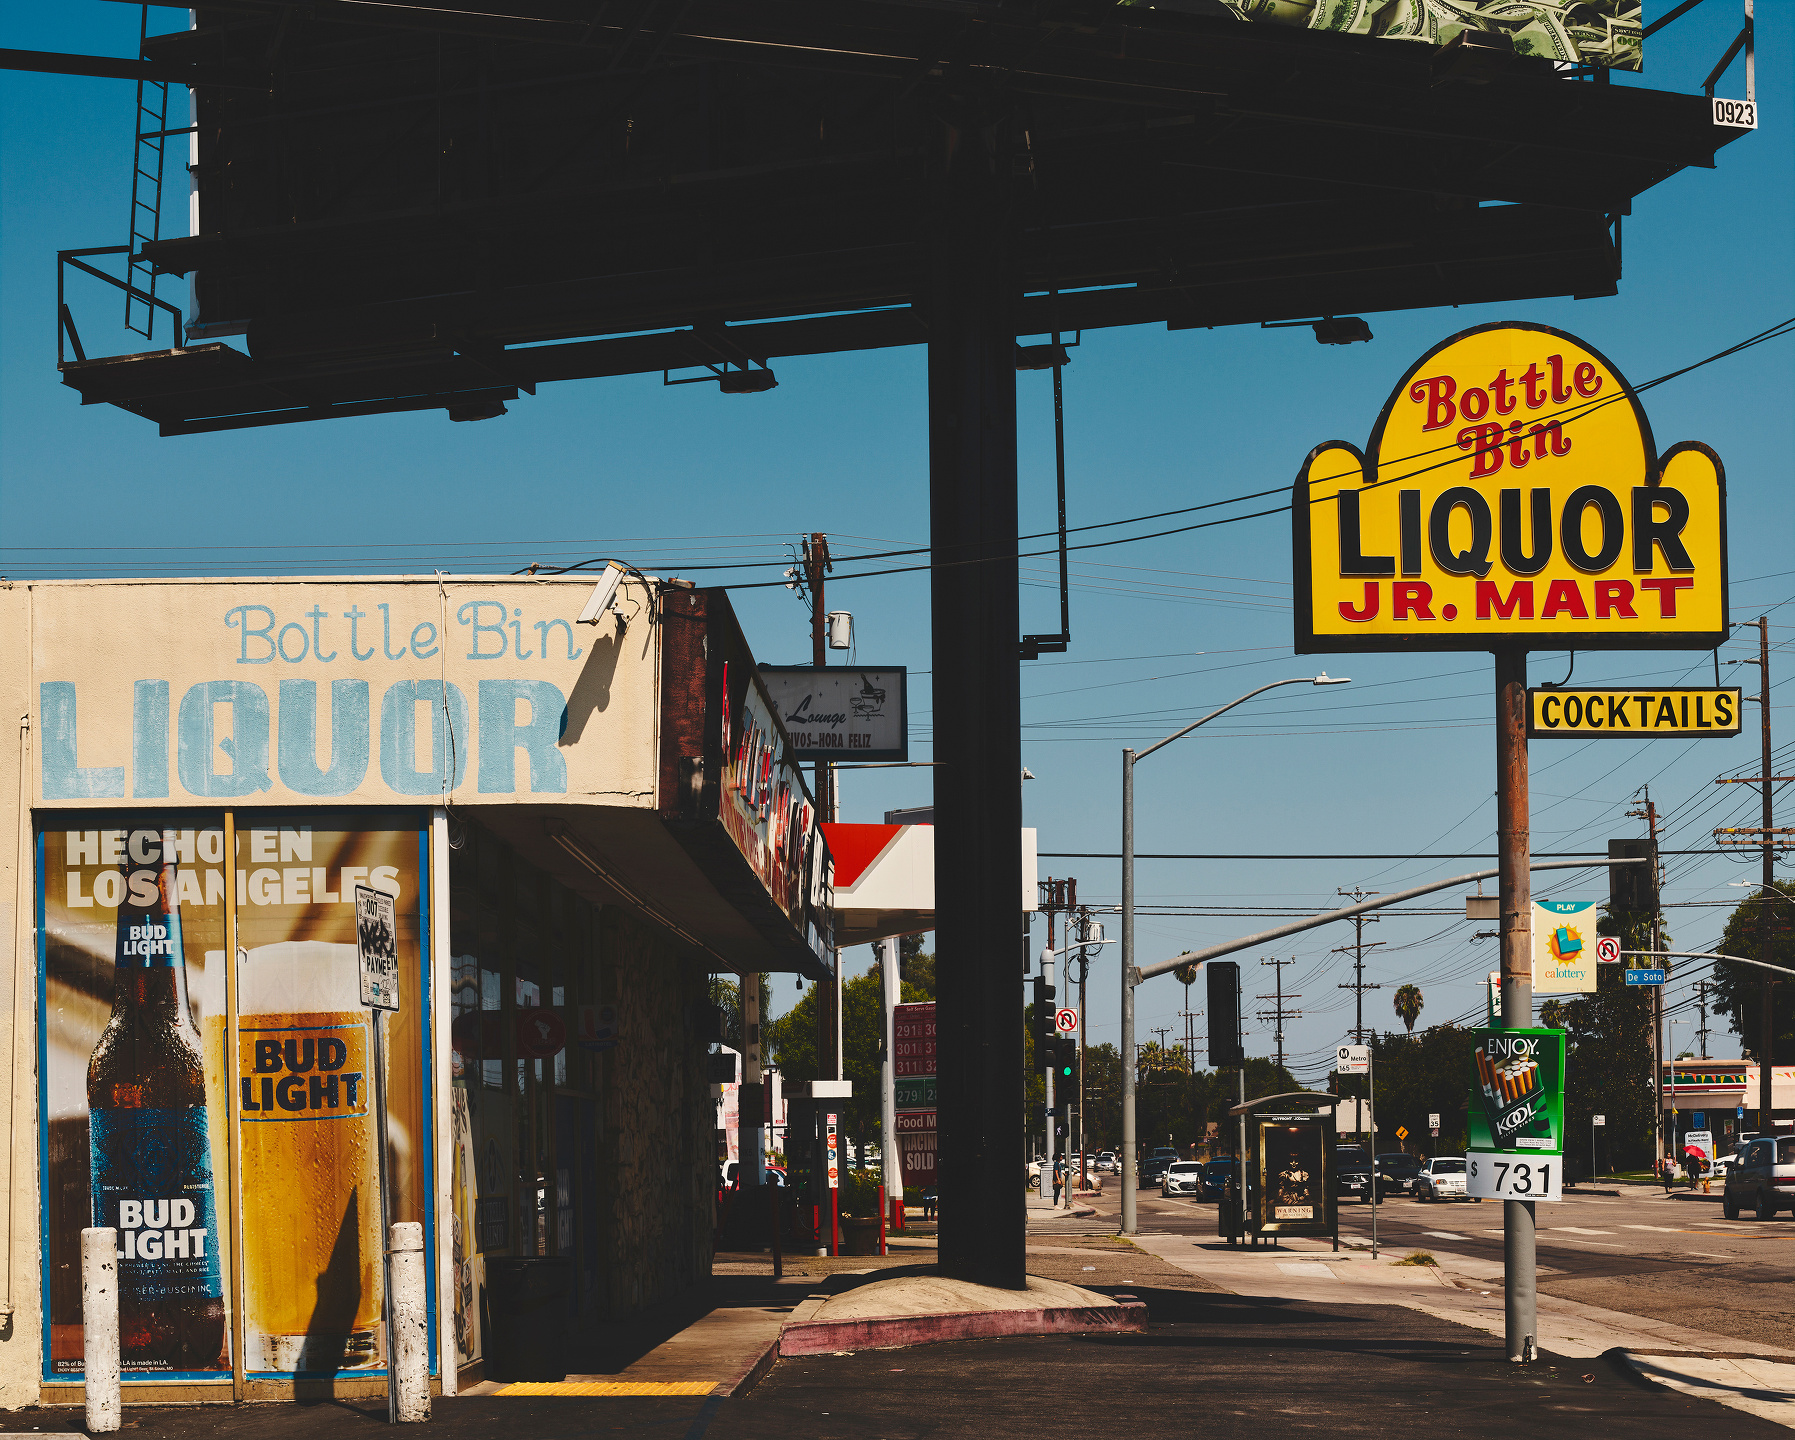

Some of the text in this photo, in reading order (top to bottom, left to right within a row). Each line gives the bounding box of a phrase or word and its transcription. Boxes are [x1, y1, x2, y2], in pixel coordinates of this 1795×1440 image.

[1715, 101, 1754, 126] 0923
[1409, 354, 1603, 432] Bottle
[1457, 419, 1572, 479] Bin
[1338, 484, 1695, 577] LIQUOR
[1338, 577, 1694, 622] JR. MART
[225, 601, 583, 664] Bottle Bin
[786, 694, 847, 729] Lounge
[1541, 693, 1734, 728] COCKTAILS
[40, 678, 569, 800] LIQUOR
[849, 733, 872, 748] FELIZ
[66, 827, 312, 866] HECHO EN
[66, 865, 400, 908] LOS ANGELES
[129, 925, 167, 940] BUD
[123, 940, 173, 956] LIGHT
[1545, 968, 1587, 981] calottery
[1628, 973, 1662, 982] De Soto
[897, 1025, 916, 1037] 291
[255, 1037, 347, 1073] BUD
[897, 1043, 917, 1055] 301
[1488, 1038, 1539, 1060] ENJOY.
[897, 1061, 917, 1073] 311
[241, 1072, 362, 1111] LIGHT
[898, 1090, 917, 1102] 279
[897, 1115, 923, 1128] Food
[1496, 1102, 1537, 1136] KOOL
[906, 1152, 934, 1170] SOLD
[1471, 1160, 1478, 1178] $
[119, 1198, 195, 1229] BUD
